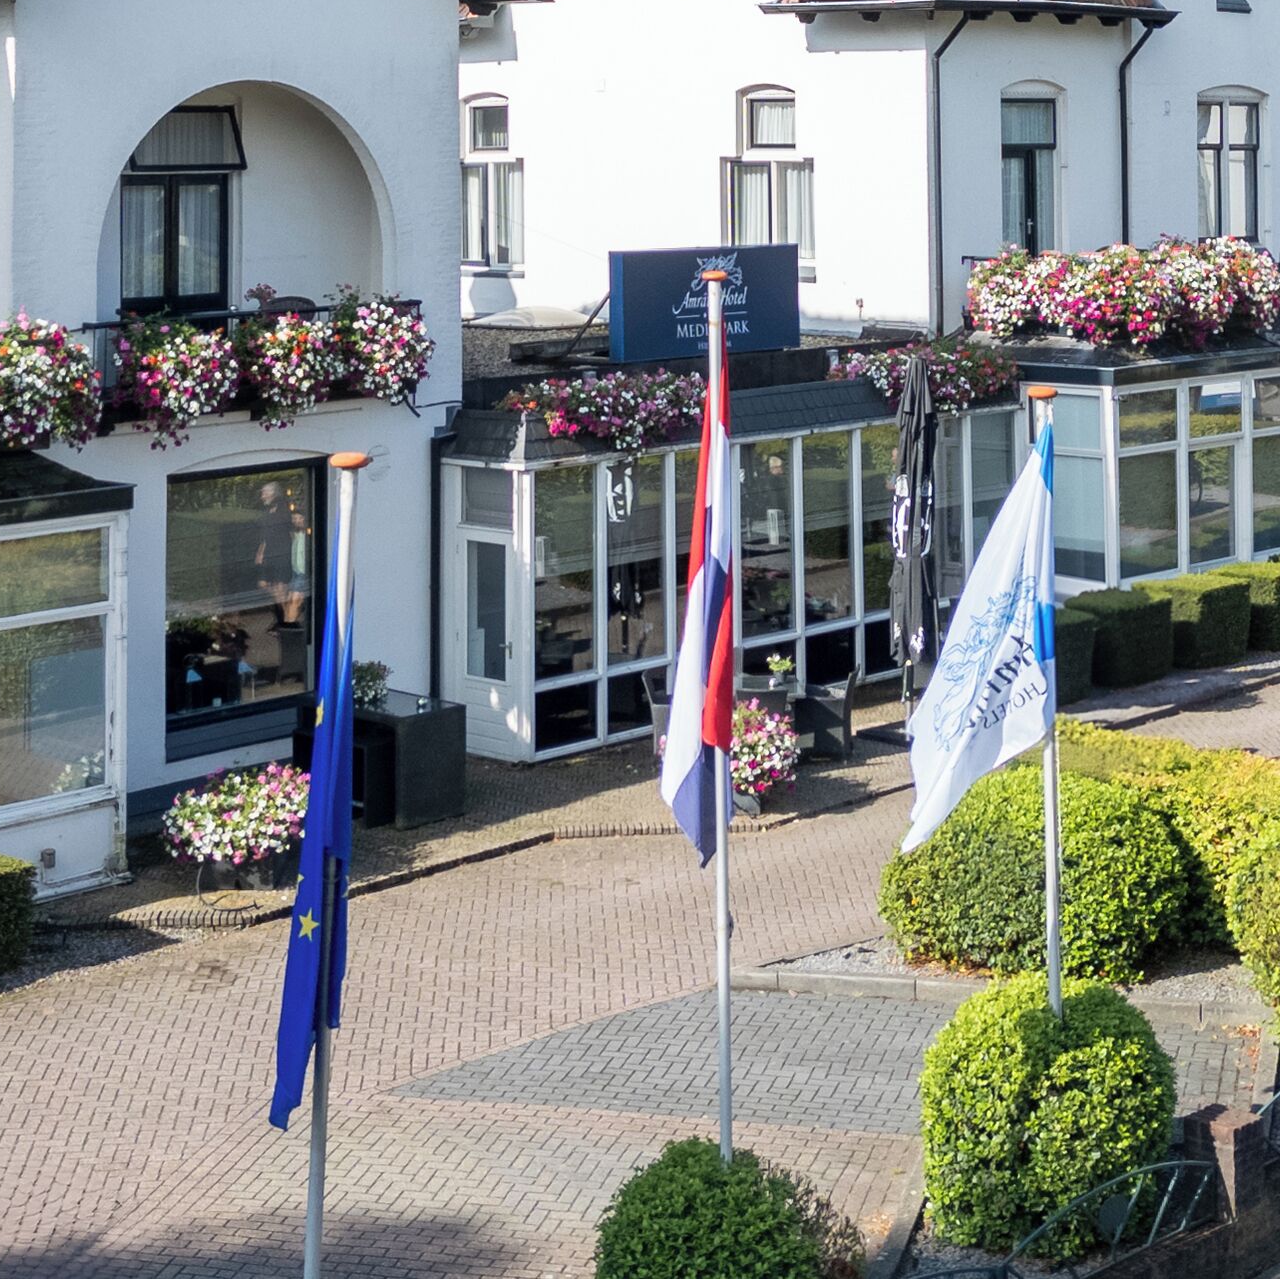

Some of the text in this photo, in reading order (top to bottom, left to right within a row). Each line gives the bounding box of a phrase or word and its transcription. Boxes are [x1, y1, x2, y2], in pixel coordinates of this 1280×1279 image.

[672, 286, 748, 314] Amrâ Hotel
[677, 321, 749, 338] MEDI ARK
